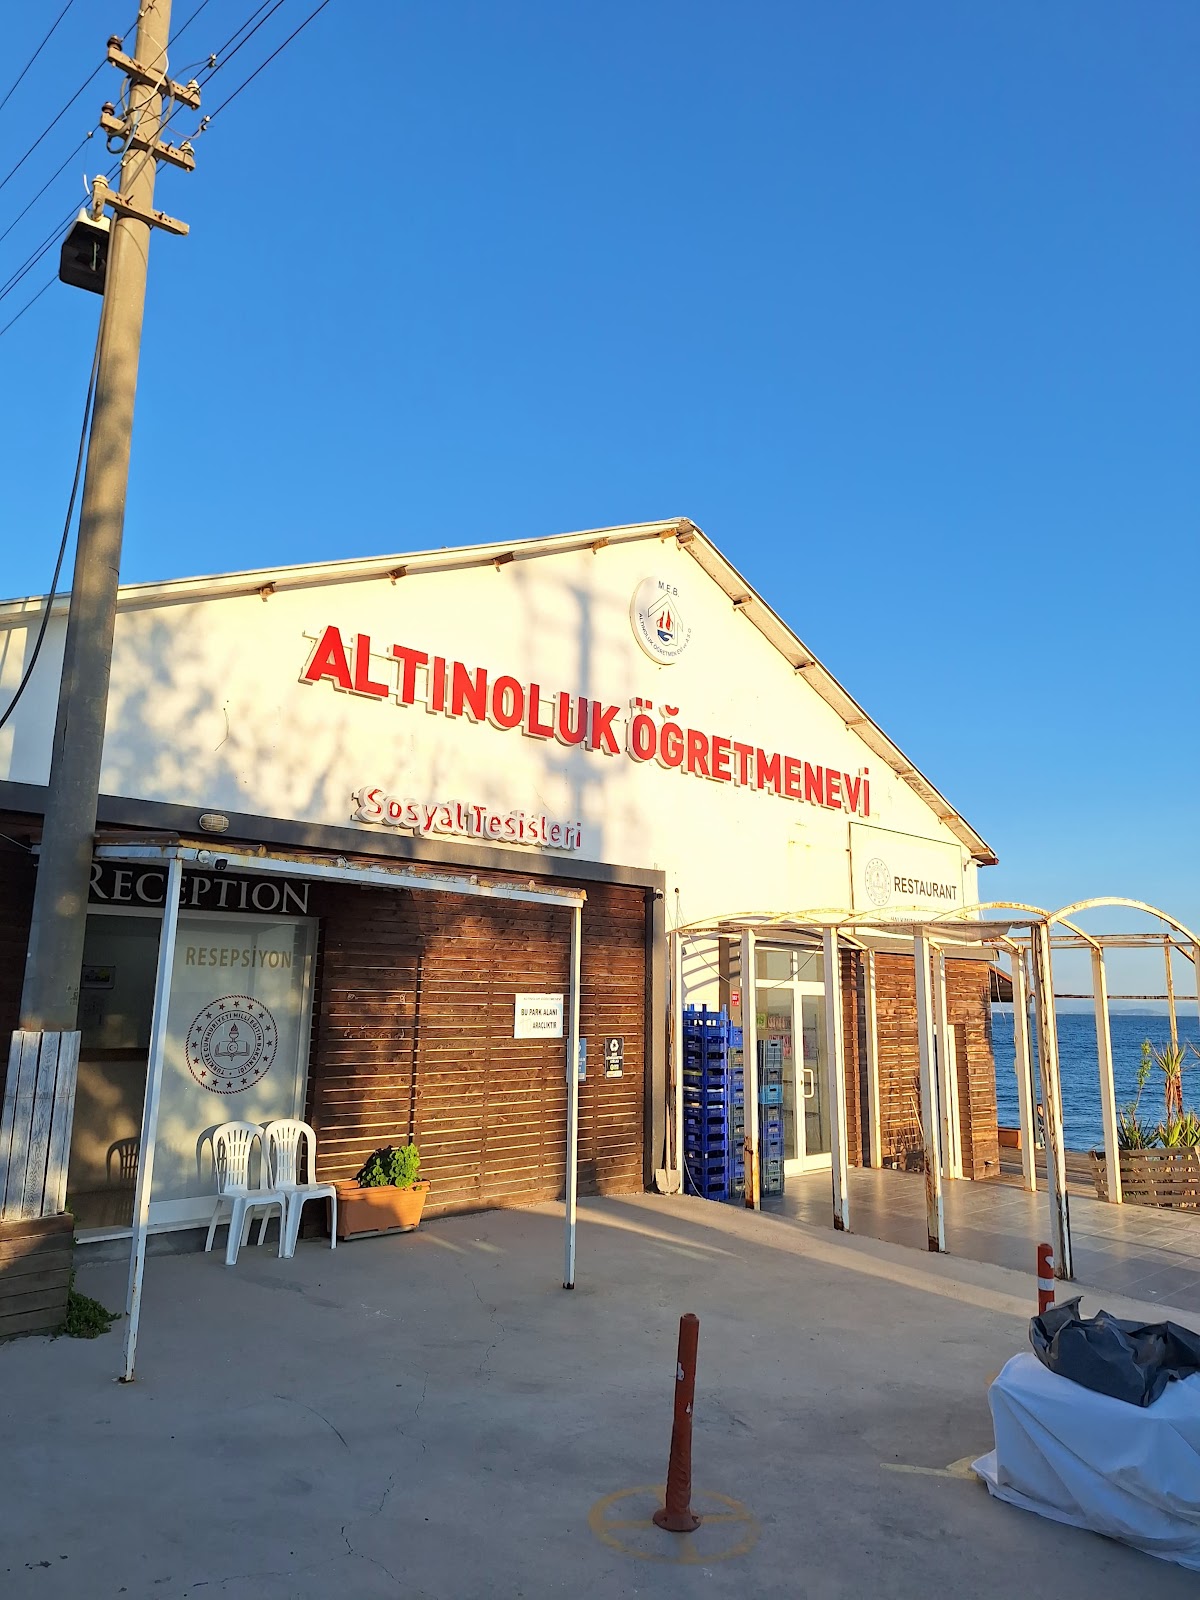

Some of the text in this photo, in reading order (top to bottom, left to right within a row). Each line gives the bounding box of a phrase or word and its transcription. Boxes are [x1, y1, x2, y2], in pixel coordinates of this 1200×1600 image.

[300, 625, 870, 818] ALTINOLUK ÖĞRETMENEVİ
[357, 785, 582, 850] Sosyal Tesisleri
[894, 877, 957, 900] RESTAURANT
[185, 945, 293, 969] RESEPSİYON
[521, 1008, 558, 1016] BU PARK ALANI
